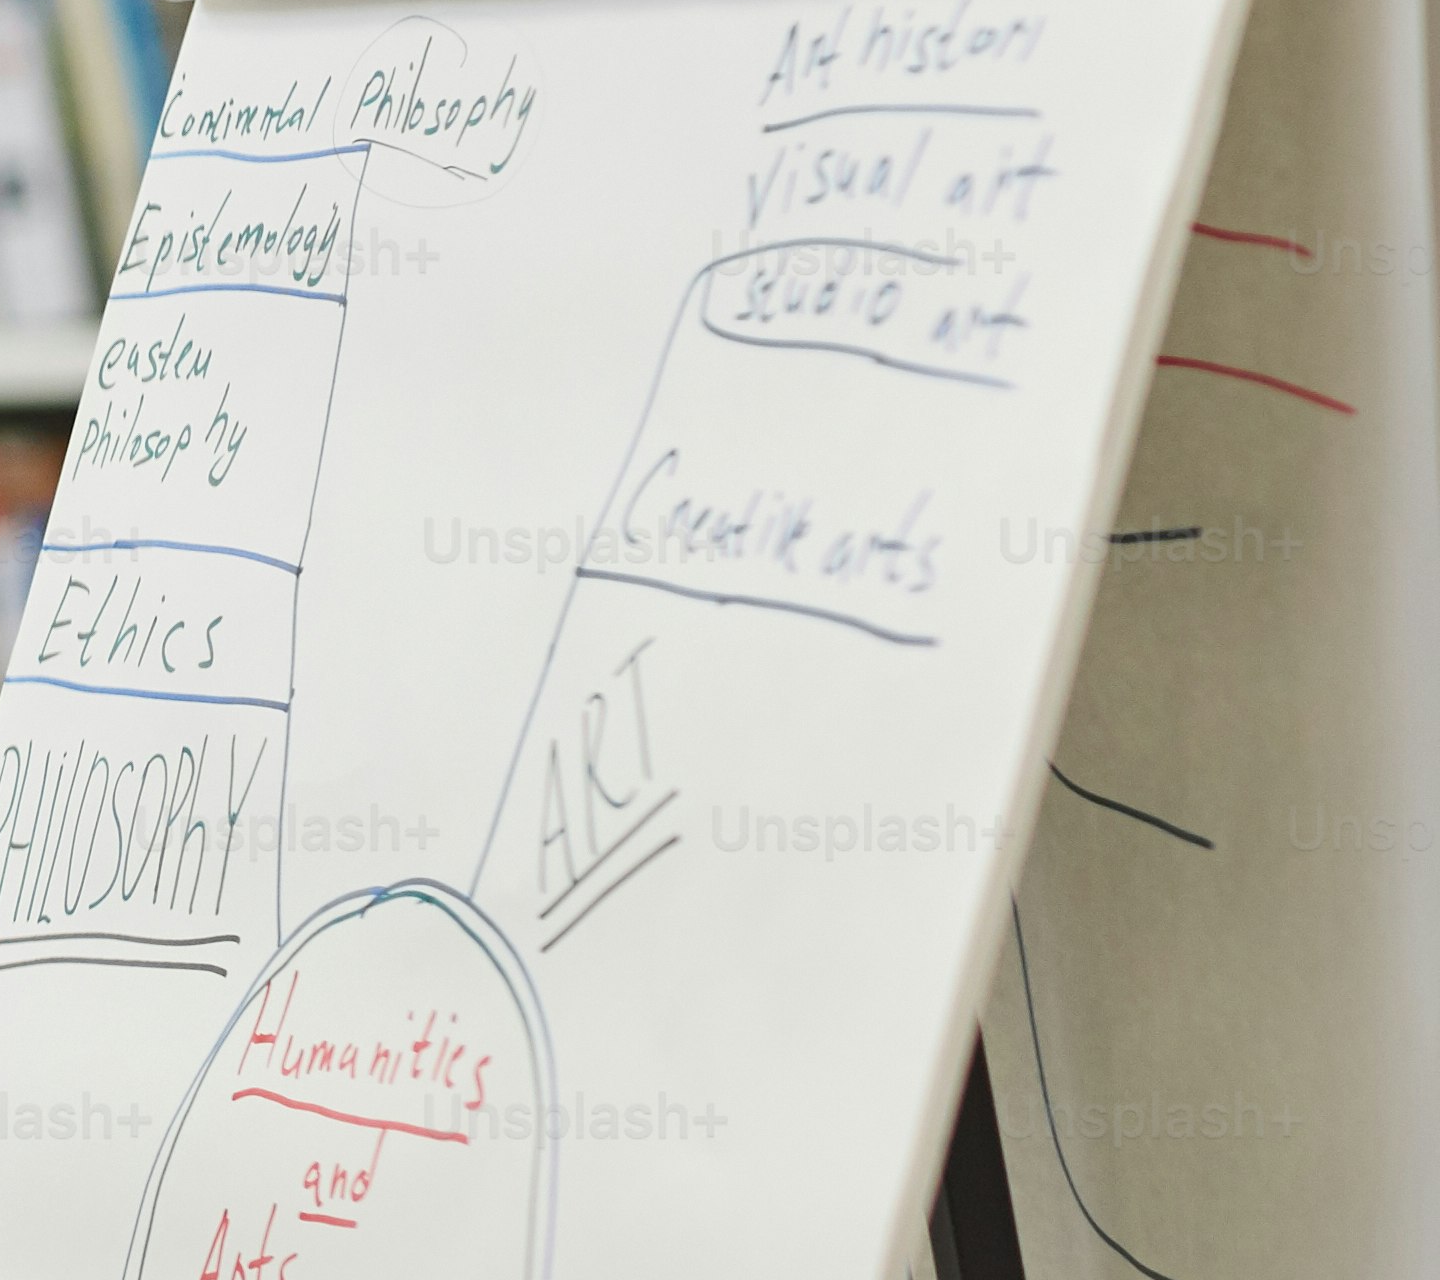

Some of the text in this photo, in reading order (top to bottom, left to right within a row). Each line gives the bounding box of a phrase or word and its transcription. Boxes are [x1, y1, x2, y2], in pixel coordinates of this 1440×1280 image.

[351, 36, 538, 175] Philosophy
[945, 132, 1062, 222] art
[119, 183, 342, 293] Epistemology
[932, 272, 1032, 361] art
[821, 488, 944, 593] arts
[37, 574, 224, 672] Ethics
[536, 637, 657, 895] ART
[237, 969, 493, 1111] Humanities
[302, 1125, 387, 1208] and
